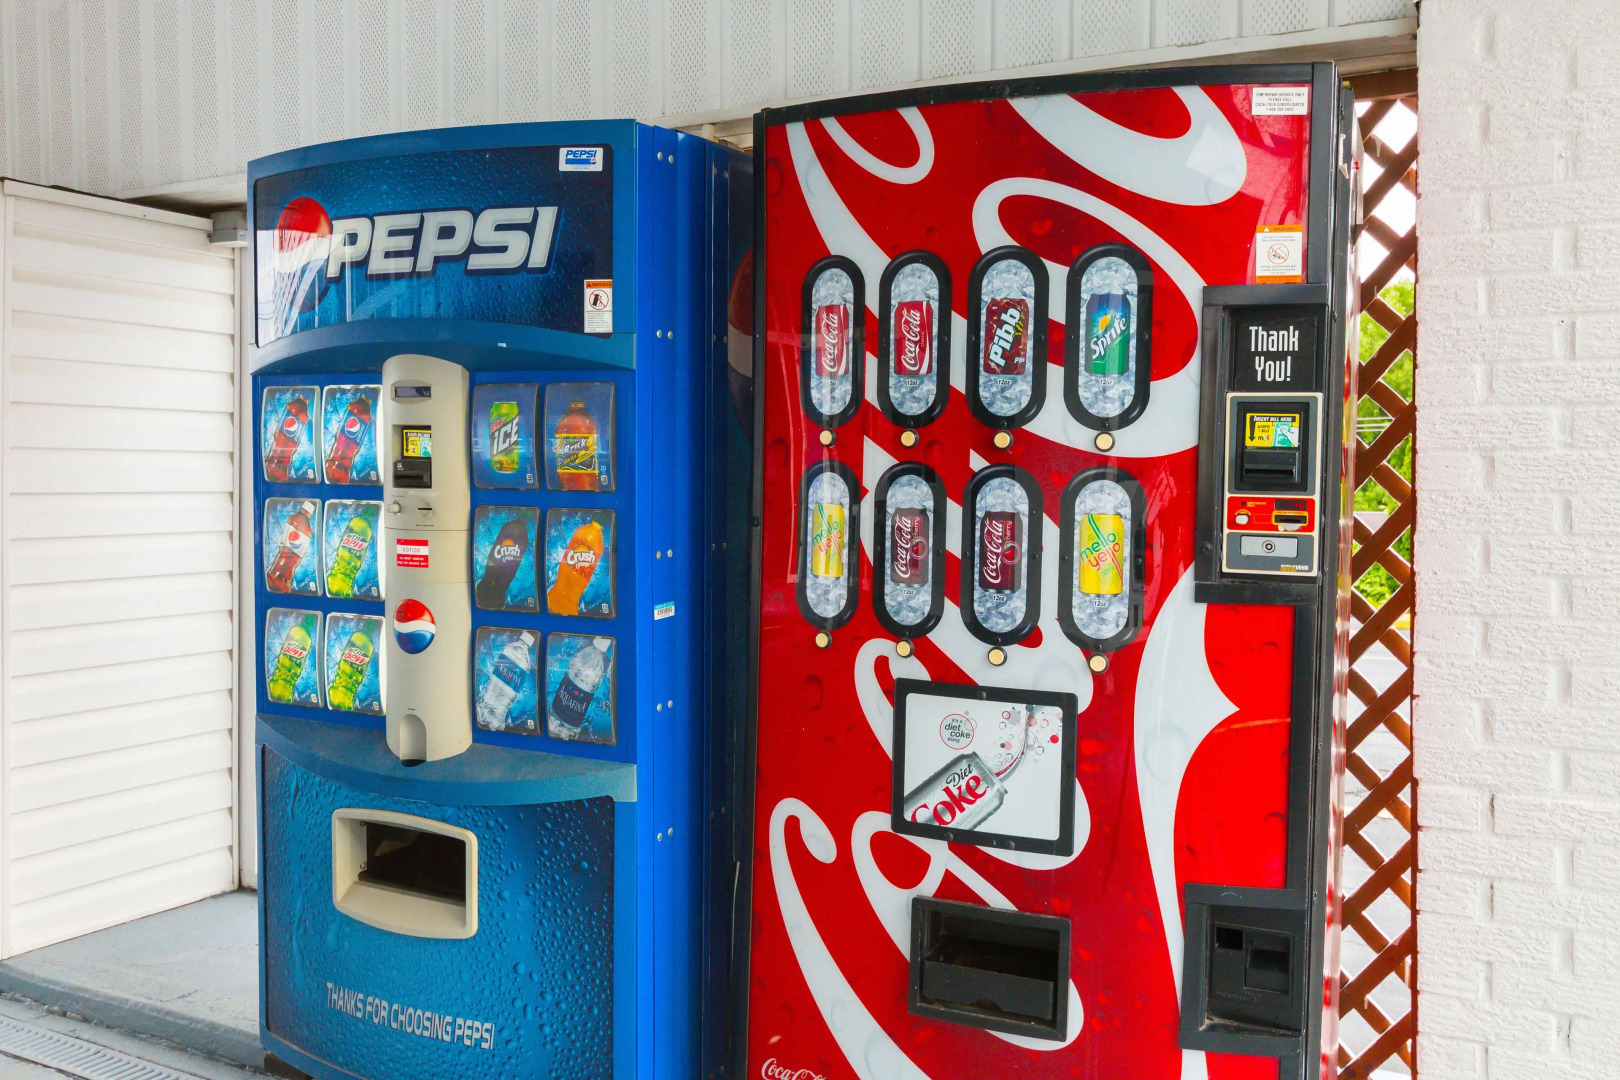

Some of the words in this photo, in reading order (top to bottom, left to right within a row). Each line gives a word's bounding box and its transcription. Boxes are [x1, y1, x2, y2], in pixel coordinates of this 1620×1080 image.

[565, 149, 597, 158] PEPSI
[326, 206, 558, 278] PEPSI
[901, 307, 921, 371] Coca-Cola
[989, 307, 1021, 367] Pibb
[1090, 317, 1127, 360] Sprite
[1249, 325, 1299, 352] Thank
[1255, 355, 1291, 382] You!
[493, 415, 519, 455] ICE
[494, 544, 521, 559] Crush
[566, 548, 596, 566] Crush
[894, 513, 912, 578] Coca-Cola
[983, 517, 1003, 584] Coca-Cola
[1080, 532, 1117, 562] mello
[560, 685, 587, 713] AQUAFINA
[944, 722, 962, 731] diet
[950, 730, 971, 739] coke
[945, 763, 974, 788] Diet
[911, 775, 988, 826] Coke
[326, 981, 364, 1019] THANKS
[366, 996, 389, 1027] FOR
[390, 1003, 453, 1043] CHOOSING
[453, 1018, 496, 1051] PEPSI
